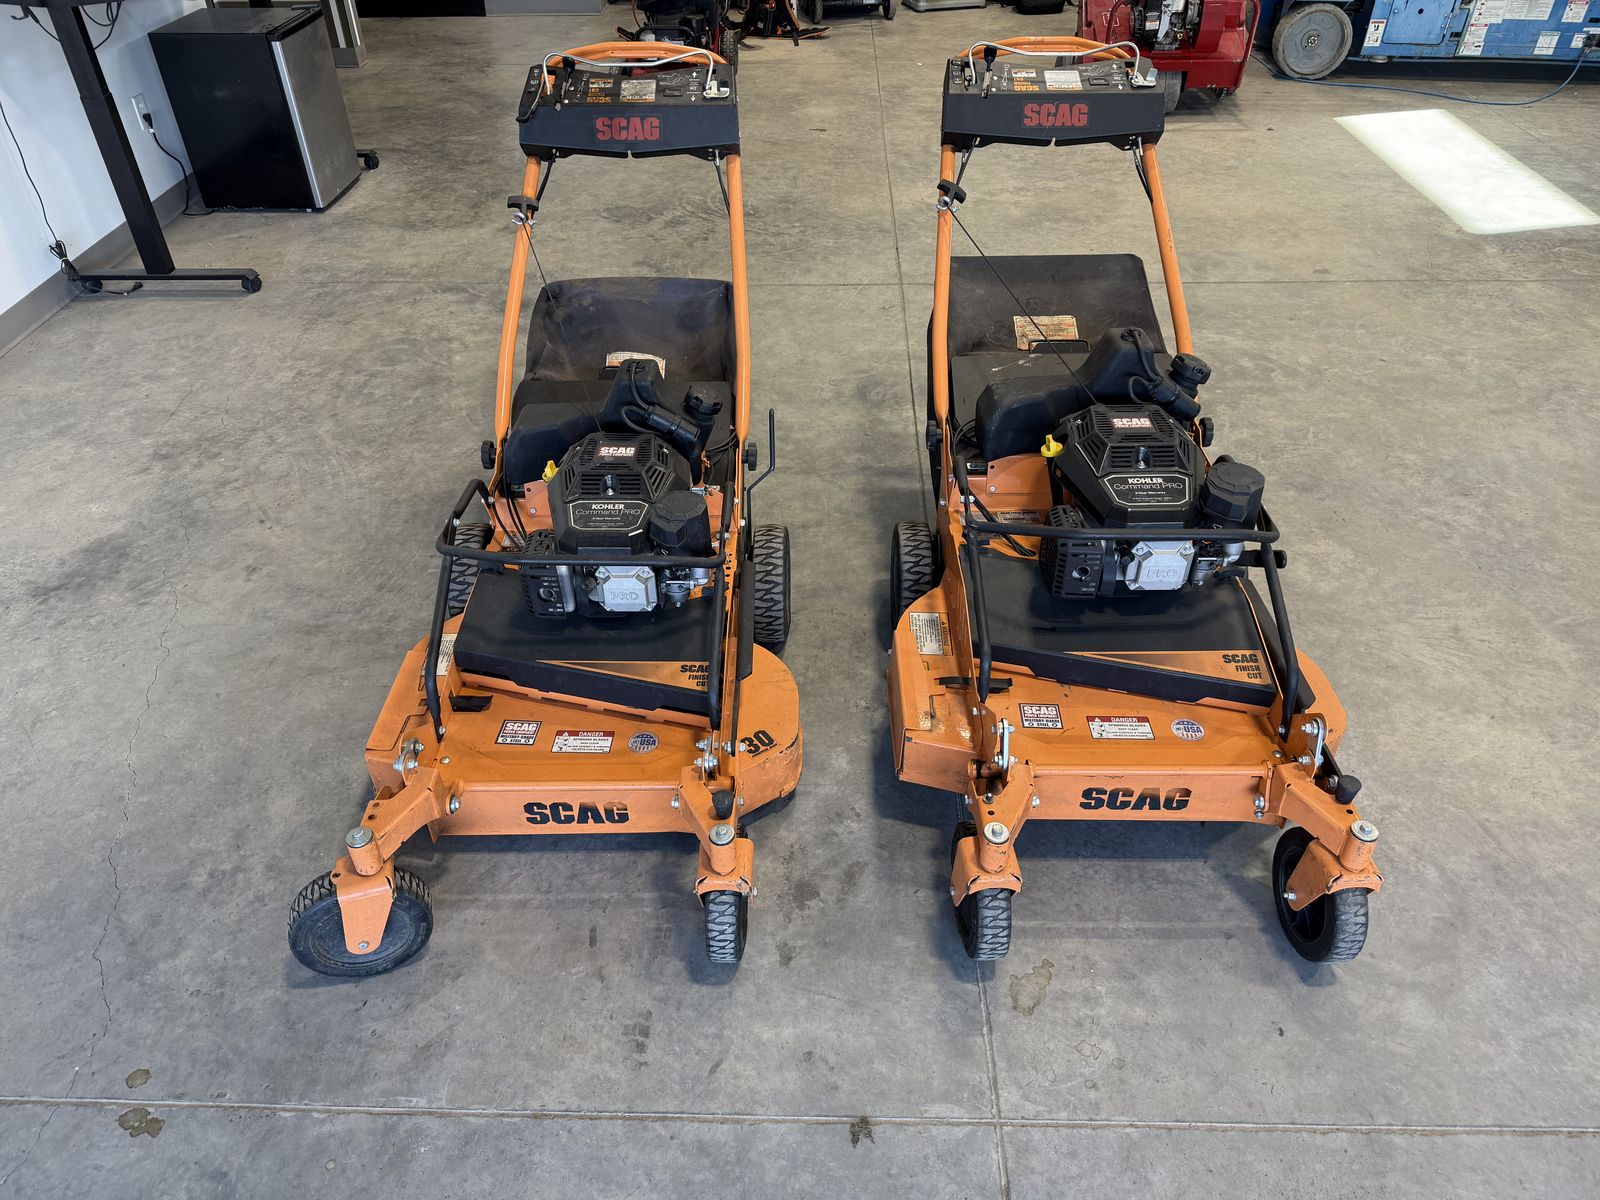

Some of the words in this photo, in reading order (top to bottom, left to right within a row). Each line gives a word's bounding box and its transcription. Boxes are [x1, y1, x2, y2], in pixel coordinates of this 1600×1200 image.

[1024, 103, 1088, 126] SCAG
[595, 117, 660, 141] SCAG
[1147, 569, 1177, 579] PRO
[610, 591, 639, 601] PRO
[1222, 654, 1259, 664] SCAG
[1023, 706, 1057, 715] SCAG
[504, 722, 538, 731] SCAG
[1184, 725, 1203, 734] USA
[740, 730, 775, 754] 30
[1079, 787, 1193, 811] SCAG
[523, 802, 630, 825] SCAG
